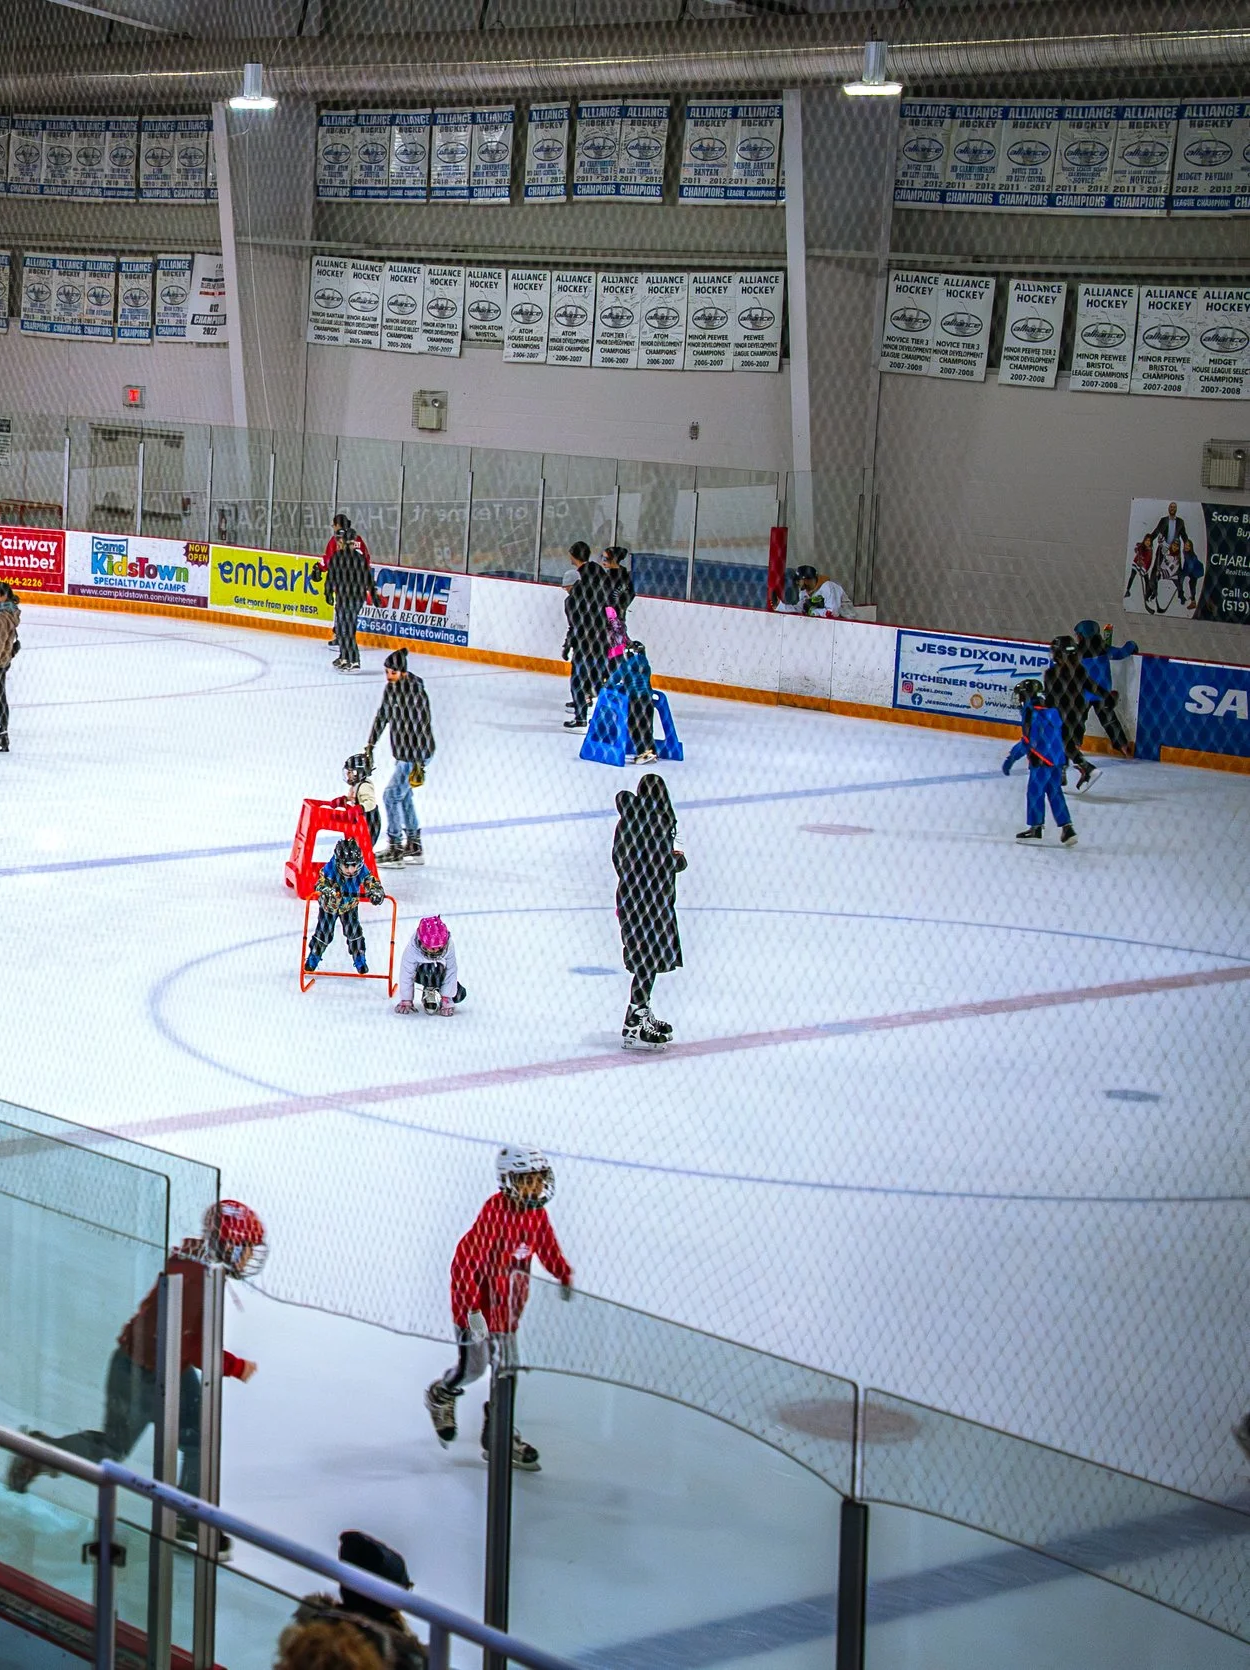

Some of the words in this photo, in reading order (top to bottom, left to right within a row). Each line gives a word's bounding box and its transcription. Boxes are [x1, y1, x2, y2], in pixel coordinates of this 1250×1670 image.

[582, 107, 620, 118] ALLIANCE
[904, 105, 951, 117] ALLIANCE
[1124, 106, 1178, 118] ALLIANCE
[1184, 105, 1240, 117] ALLIANCE
[1129, 121, 1171, 130] HOCKEY
[1189, 120, 1233, 128] HOCKEY
[577, 185, 616, 194] CHAMPIONS
[894, 189, 940, 201] CHAMPIONS
[1113, 196, 1165, 208] CHAMPIONS
[160, 260, 190, 270] ALLIANCE
[315, 260, 347, 269] ALLIANCE
[317, 269, 344, 278] HOCKEY
[511, 273, 547, 281] ALLIANCE
[692, 276, 732, 284] ALLIANCE
[739, 276, 779, 284] ALLIANCE
[893, 273, 939, 285] ALLIANCE
[944, 278, 990, 289] ALLIANCE
[513, 282, 544, 291] HOCKEY
[695, 286, 728, 294] HOCKEY
[741, 286, 775, 294] HOCKEY
[895, 285, 933, 295] HOCKEY
[1014, 283, 1062, 293] ALLIANCE
[946, 289, 984, 300] HOCKEY
[1083, 288, 1133, 298] ALLIANCE
[1145, 289, 1197, 299] ALLIANCE
[1203, 290, 1250, 301] ALLIANC
[1016, 294, 1057, 304] HOCKEY
[1086, 299, 1128, 309] HOCKEY
[1148, 301, 1191, 310] HOCKEY
[1206, 302, 1250, 312] HOCKEY
[886, 336, 909, 344] NOVICE
[911, 337, 924, 345] TIER
[936, 341, 960, 349] NOVICE
[962, 342, 974, 350] TIER
[1022, 347, 1041, 355] PEEWEE
[939, 357, 976, 366] CHAMPIONS
[1163, 356, 1191, 364] PEEWEE
[1209, 358, 1238, 366] MIDGET
[889, 361, 922, 371] 2007-2008
[1009, 364, 1048, 372] CHAMPIONS
[1086, 362, 1114, 370] BRISTOL
[940, 367, 974, 376] 2007-2008
[1094, 371, 1129, 379] CHAMPIONS
[1010, 373, 1045, 382] 2007-2008
[1142, 373, 1185, 381] CHAMPIONS
[1199, 376, 1243, 384] CHAMPIONS
[1081, 380, 1118, 389] 2007-2008
[1143, 383, 1182, 392] 2007-2008
[1201, 385, 1241, 395] 2007-2008
[1212, 511, 1239, 523] Score
[189, 543, 208, 553] NOW
[188, 553, 208, 562] OPEN
[91, 552, 189, 583] KidsTown
[218, 556, 320, 595] embark
[93, 576, 138, 588] SPECIALTY
[139, 580, 157, 591] DAY
[158, 582, 186, 593] CAMPS
[1221, 588, 1240, 598] Call
[234, 595, 246, 605] Get
[247, 598, 264, 607] more
[265, 599, 281, 609] from
[283, 602, 298, 612] your
[300, 604, 319, 615] RESP.
[1222, 599, 1250, 614] (519)
[390, 611, 397, 621] &
[400, 612, 449, 627] RECOVERY
[400, 626, 467, 644] activetowing.ca
[916, 643, 957, 657] JESS
[960, 648, 1017, 666] DIXON,
[901, 671, 967, 688] KITCHENER
[969, 681, 1007, 693] SOUTH
